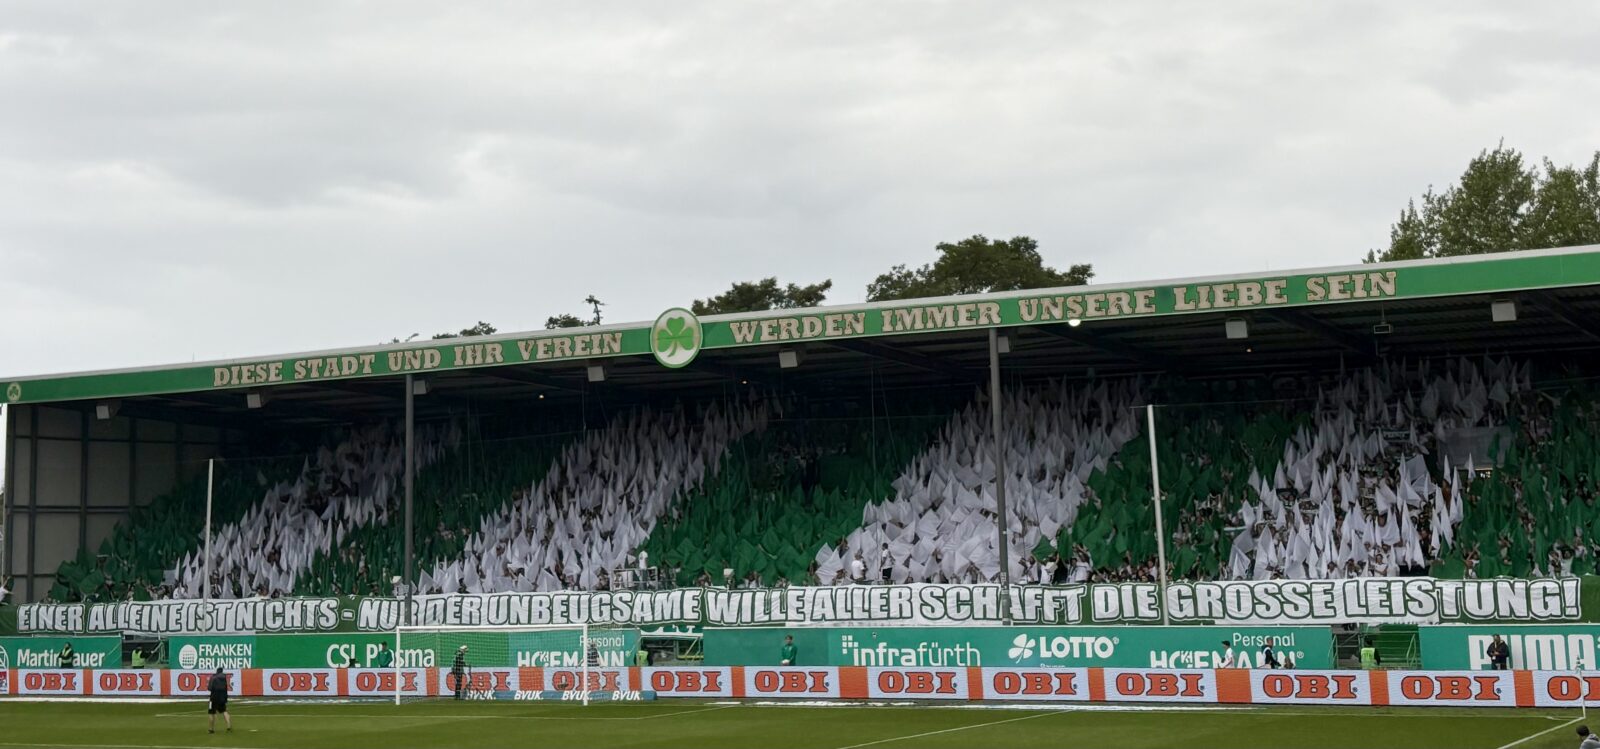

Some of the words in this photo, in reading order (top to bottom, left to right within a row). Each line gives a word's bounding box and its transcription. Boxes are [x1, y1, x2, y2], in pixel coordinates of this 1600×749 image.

[213, 362, 283, 387] DIESE
[294, 354, 375, 380] STADT
[387, 348, 441, 372] UND
[453, 343, 504, 367] IHR
[517, 333, 622, 361] VEREIN
[729, 312, 866, 345] WERDEN
[881, 301, 1002, 332] IMMER
[1018, 289, 1157, 322] UNSERE
[1173, 279, 1288, 312] LIEBE
[1305, 271, 1397, 302] SEIN
[18, 603, 85, 633] EINER
[87, 602, 184, 632] ALLEINE
[186, 602, 232, 632] IST
[235, 599, 340, 631] NICHTS
[424, 594, 482, 626] DER
[486, 588, 703, 625] UNBEUGSAME
[704, 587, 806, 626] WILLE
[811, 585, 913, 620] ALLER
[1091, 581, 1161, 622] DIE
[1166, 580, 1336, 620] GROSSE
[1342, 578, 1581, 621] LEISTUNG!
[199, 644, 252, 656] FRANKEN
[326, 643, 361, 668] CSL
[853, 641, 982, 667] infrafürth
[1039, 636, 1114, 659] LOTTO
[68, 650, 105, 667] auer
[199, 657, 252, 669] BRUNNEN
[25, 673, 76, 690] OBI
[100, 673, 153, 691] OBI
[270, 672, 329, 691] OBI
[356, 672, 417, 691] OBI
[552, 671, 620, 691] OBI
[651, 671, 721, 692] OBI
[755, 671, 828, 692] OBI
[878, 671, 956, 693] OBI
[993, 672, 1076, 695] OBI
[1115, 673, 1203, 697] OBI
[1262, 674, 1357, 698] OBI
[1401, 675, 1500, 700] OBI
